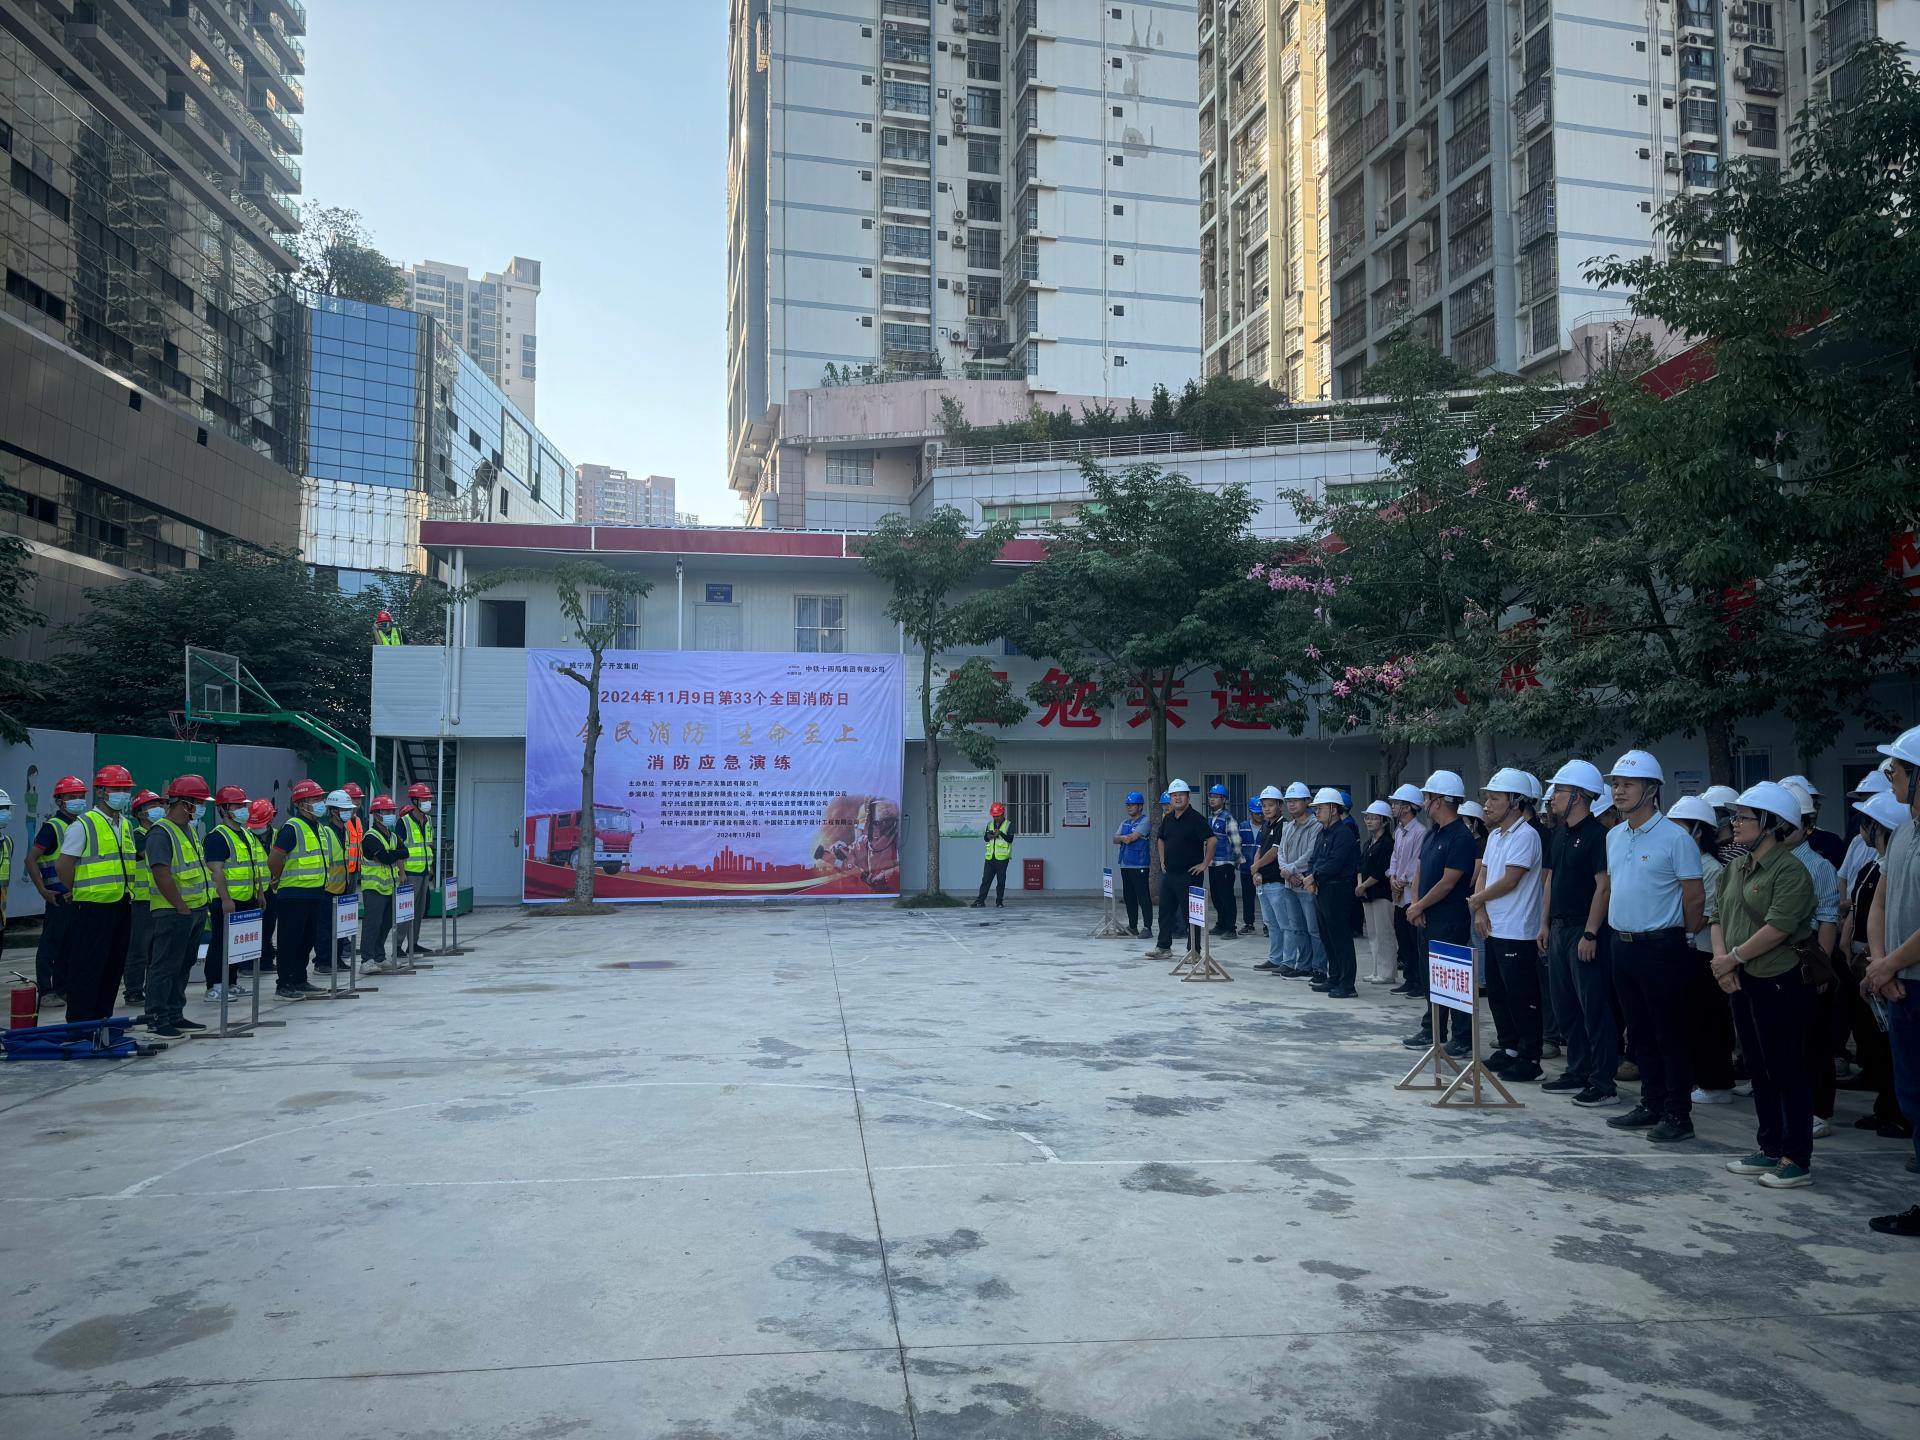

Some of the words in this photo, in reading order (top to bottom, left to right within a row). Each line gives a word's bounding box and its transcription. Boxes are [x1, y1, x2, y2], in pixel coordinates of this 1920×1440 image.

[569, 662, 639, 670] 威宁房产开发集团
[805, 665, 885, 673] 中铁十四局集团有限公司
[600, 690, 849, 706] 2024年11月9日第33个全国消防日
[737, 720, 859, 745] 生命至上
[647, 754, 792, 771] 消防应急演练
[233, 931, 259, 945] 应急救援组
[1431, 962, 1470, 995] 威宁房地产开发集团
